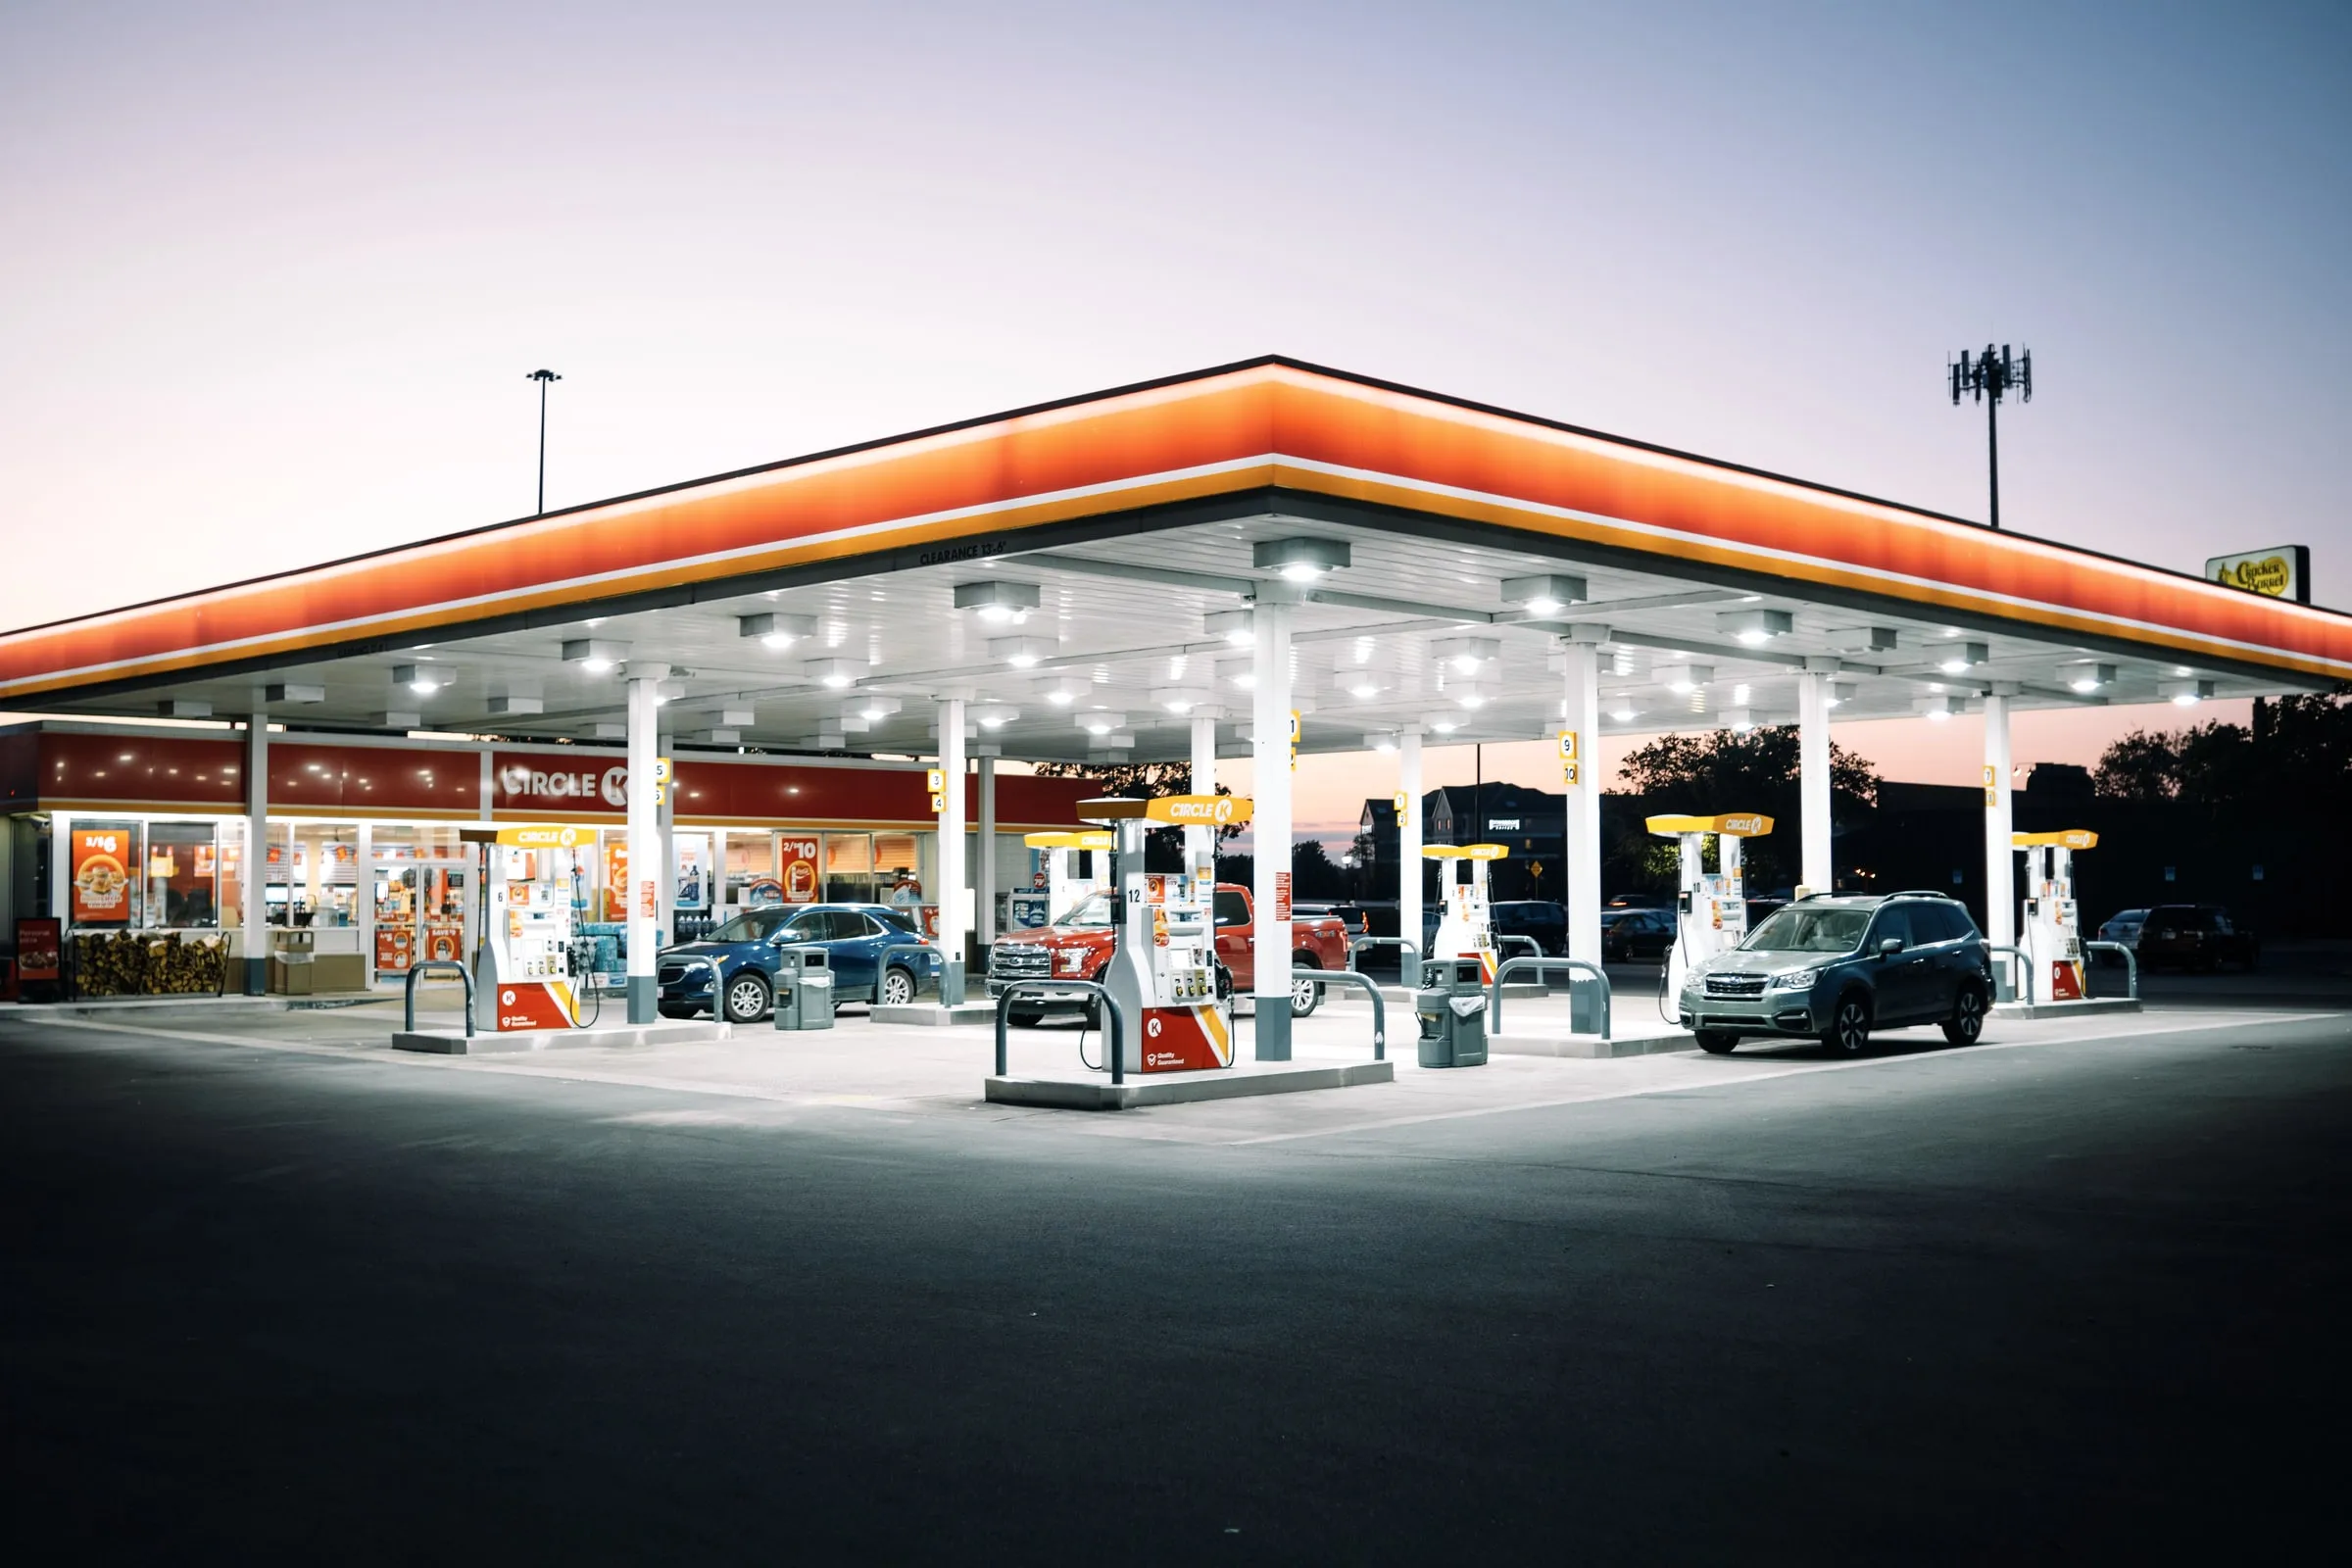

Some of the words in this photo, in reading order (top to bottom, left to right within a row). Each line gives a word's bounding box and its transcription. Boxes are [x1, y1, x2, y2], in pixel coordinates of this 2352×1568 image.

[920, 545, 978, 565] CLEARANCE
[1564, 739, 1570, 752] 9
[657, 764, 662, 775] 5
[1565, 767, 1576, 780] 10
[504, 769, 596, 798] CIRCLE
[933, 776, 939, 785] 3
[936, 799, 942, 808] 4
[1170, 803, 1214, 817] CIRCLE
[1726, 818, 1751, 831] CIRCLE
[517, 831, 558, 843] CIRCLE
[1693, 882, 1700, 893] 10
[498, 892, 503, 902] 6
[1129, 889, 1140, 903] 12
